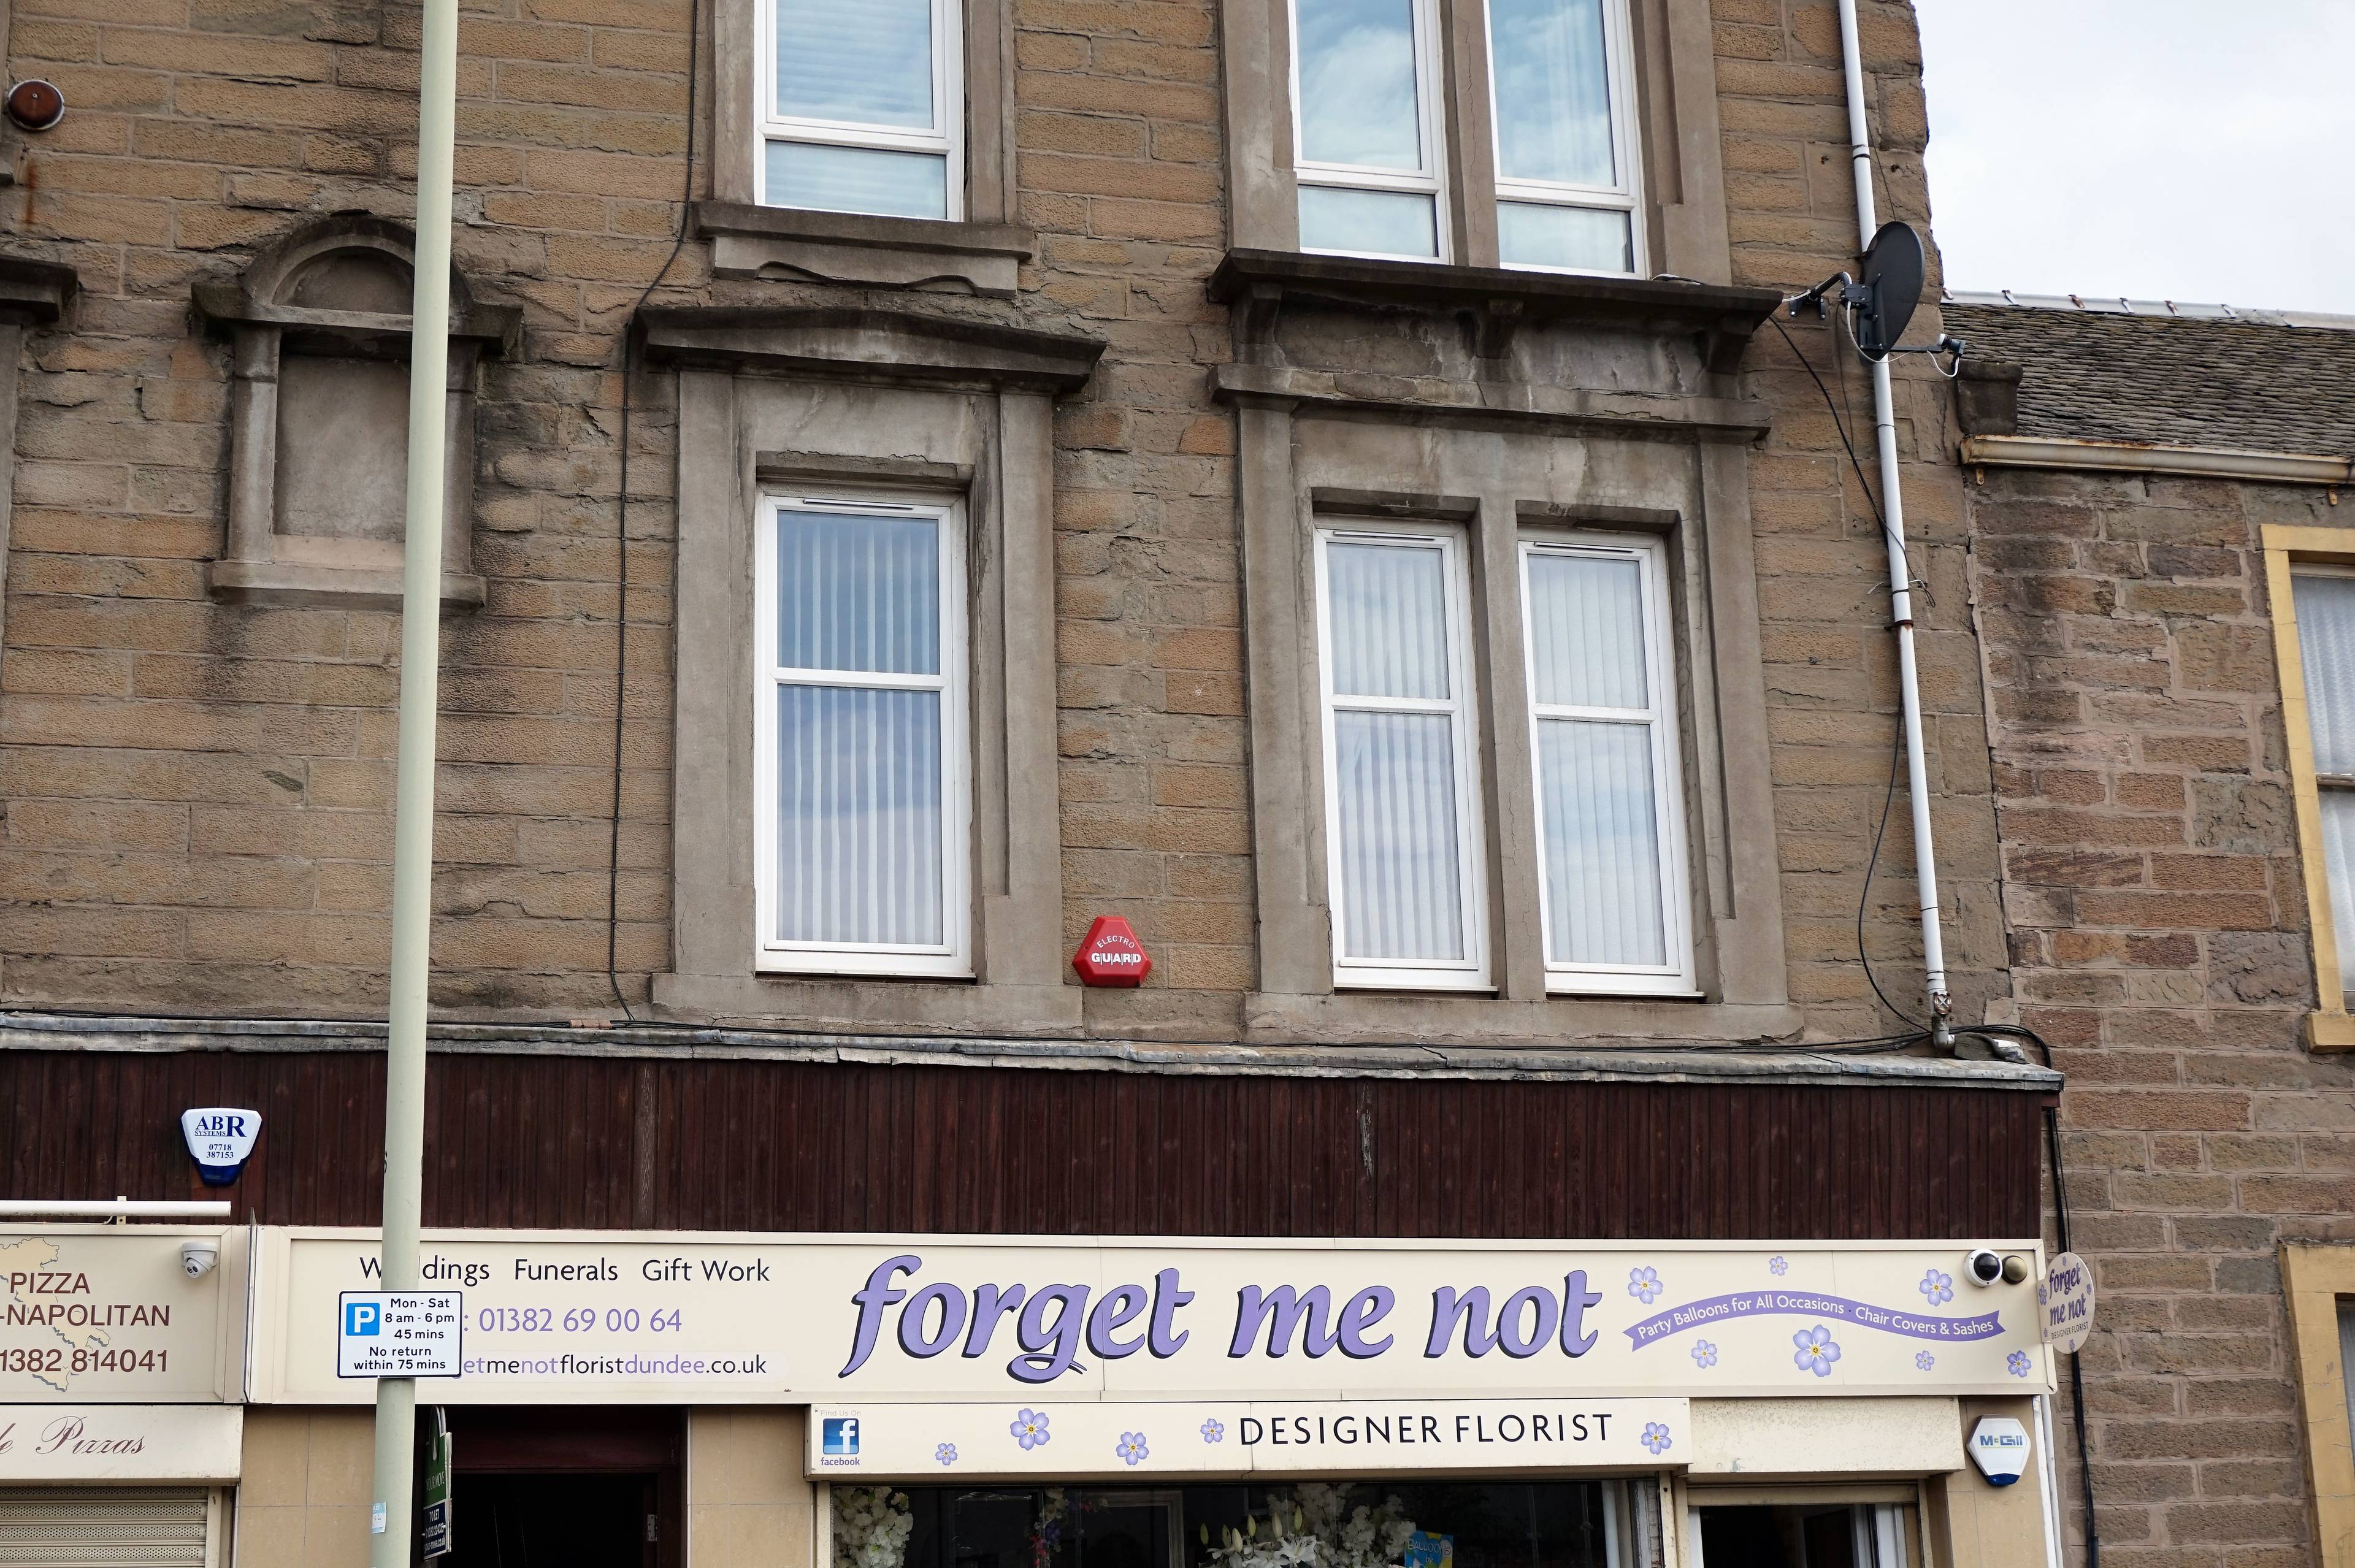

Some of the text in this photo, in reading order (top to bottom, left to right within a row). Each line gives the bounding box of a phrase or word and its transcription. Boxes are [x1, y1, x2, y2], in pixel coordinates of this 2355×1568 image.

[1097, 935, 1135, 948] ELECTRO
[1091, 952, 1141, 965] GUARD
[195, 1115, 247, 1137] ABR
[359, 1255, 770, 1287] Wdings Funerals Gift Work
[2049, 1262, 2081, 1299] forget
[10, 1272, 91, 1294] PIZZA
[391, 1298, 417, 1308] Mon
[428, 1298, 450, 1308] Sat
[2050, 1293, 2086, 1326] me not
[354, 1306, 375, 1333] P
[385, 1313, 392, 1323] 8
[425, 1313, 432, 1322] 6
[436, 1315, 454, 1325] pm
[479, 1308, 682, 1332] 01382 69 00 64
[838, 1255, 1603, 1383] forget me not
[1637, 1295, 1994, 1339] Party Balloons for All Occasions Chair Covers & Sashes
[394, 1329, 444, 1339] 45 mins
[2051, 1321, 2089, 1339] DESIGNER FLORIST
[71, 1349, 167, 1372] 814041
[369, 1347, 432, 1356] No return
[354, 1360, 446, 1370] within 75 mins
[454, 1354, 767, 1379] etmenotfloristdundee.co.uk
[36, 1416, 145, 1454] Pizzas
[1240, 1414, 1612, 1445] DESIGNER FLORIST
[821, 1457, 860, 1466] facebook
[435, 1471, 445, 1487] MOVE
[429, 1510, 434, 1523] TO
